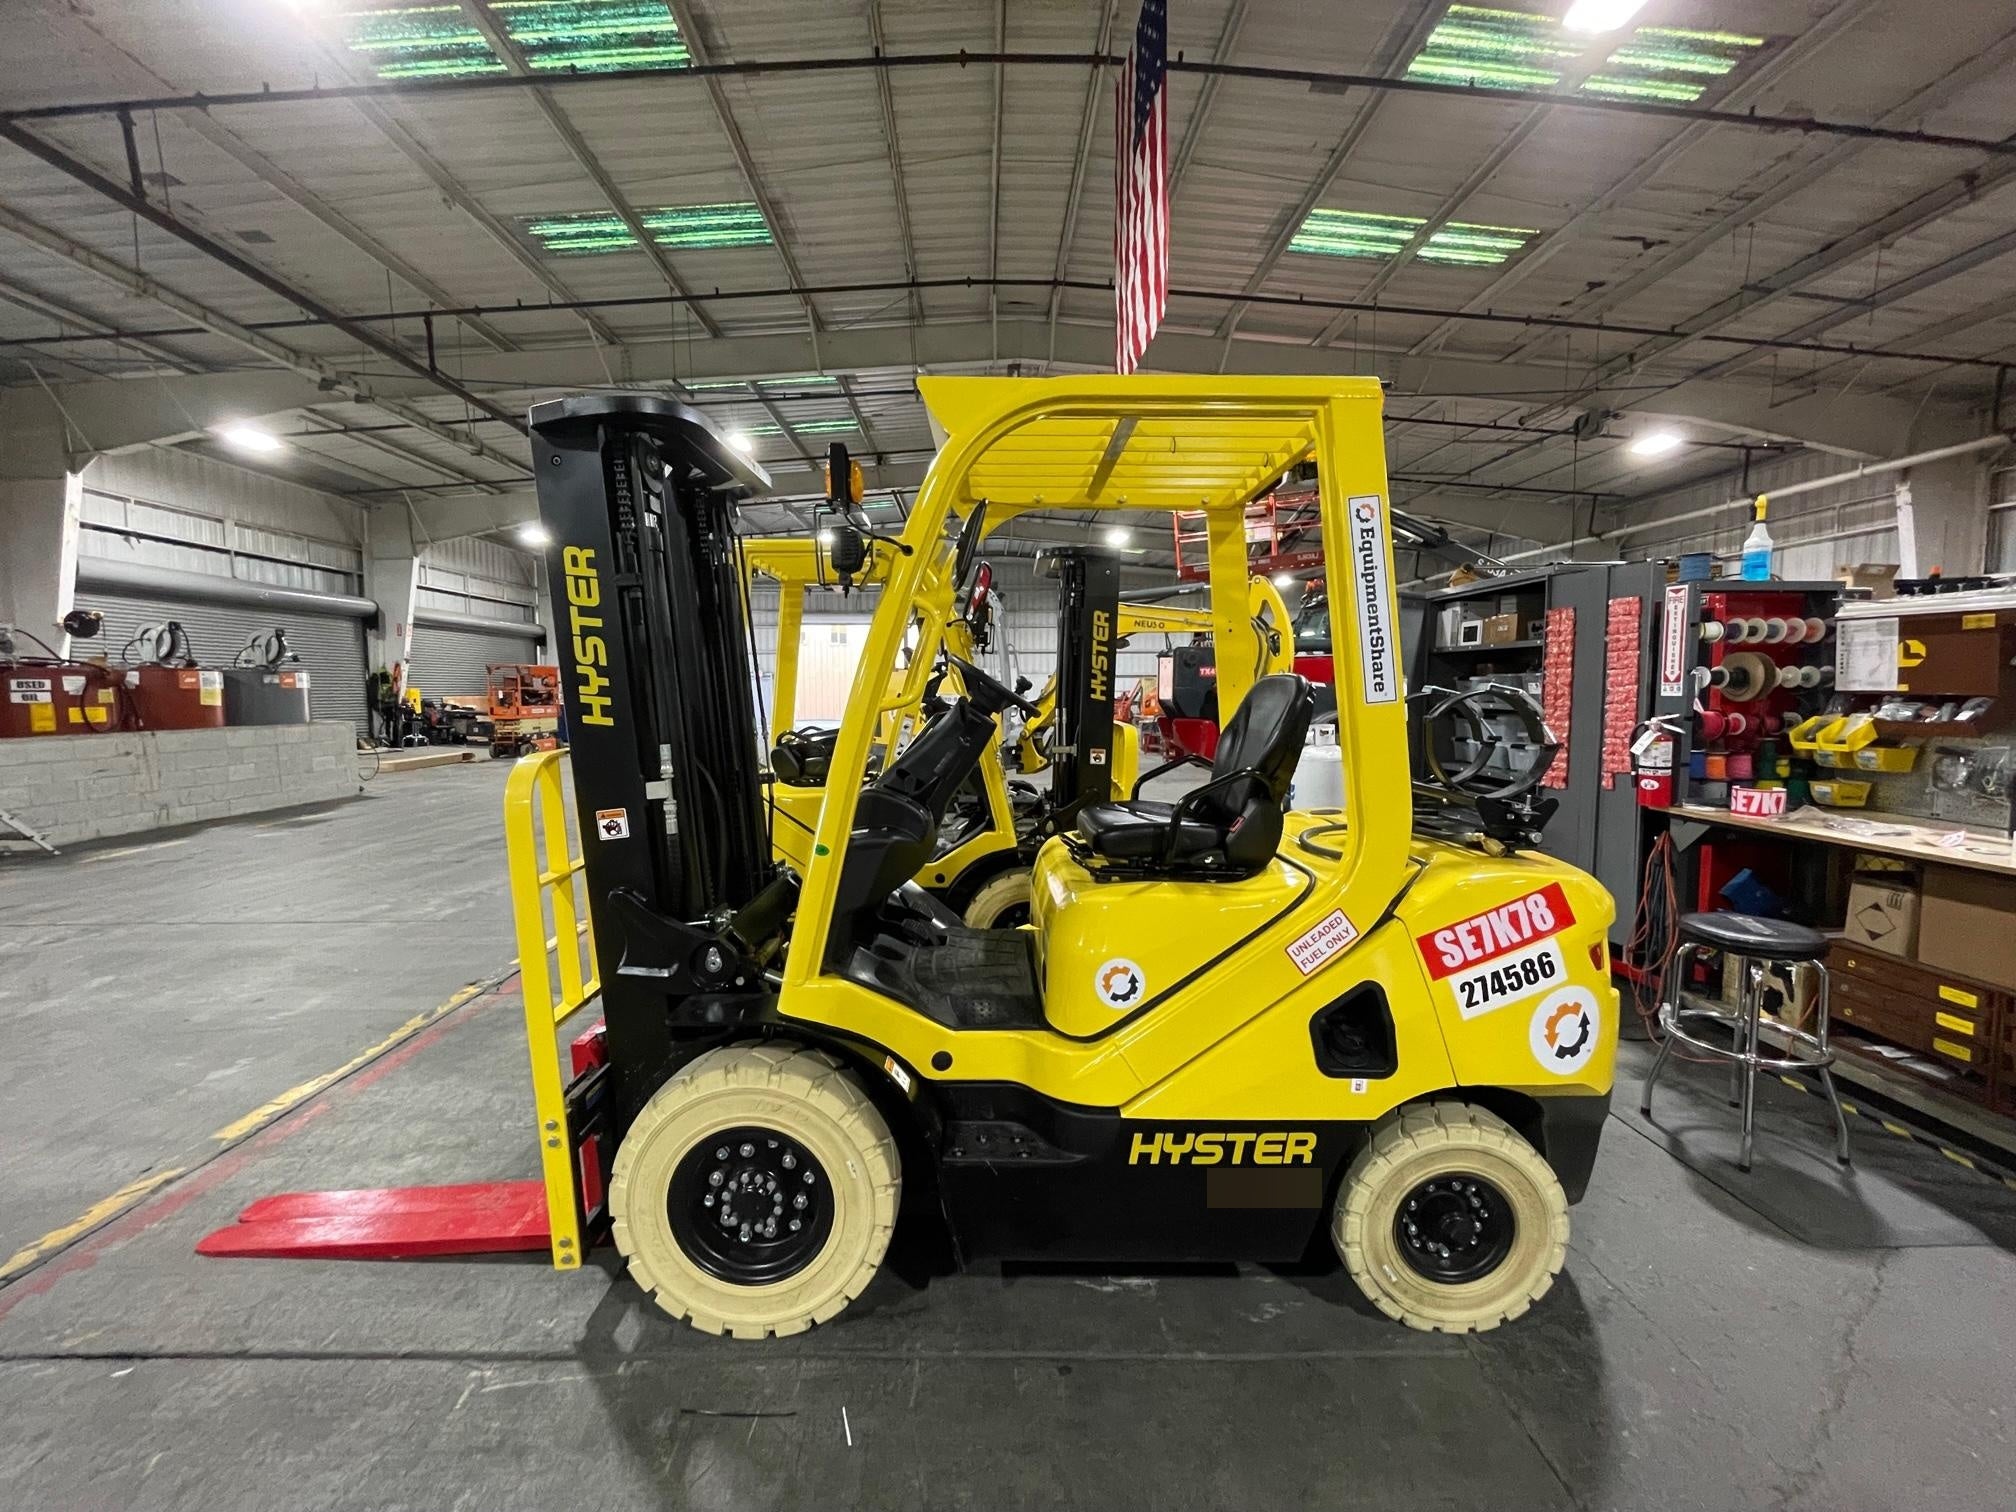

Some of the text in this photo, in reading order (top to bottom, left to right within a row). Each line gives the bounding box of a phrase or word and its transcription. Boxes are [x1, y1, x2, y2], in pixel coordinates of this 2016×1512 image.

[562, 545, 615, 727] HYSTER
[1359, 526, 1386, 693] EquipmentShare
[16, 680, 46, 689] USED
[1090, 609, 1110, 702] HYSTER
[1291, 916, 1343, 957] UNLEADED
[1300, 926, 1351, 969] FUEL ONLY
[1433, 892, 1556, 969] SE7K78
[1459, 951, 1556, 1009] 274586
[1128, 1131, 1318, 1165] HYSTER
